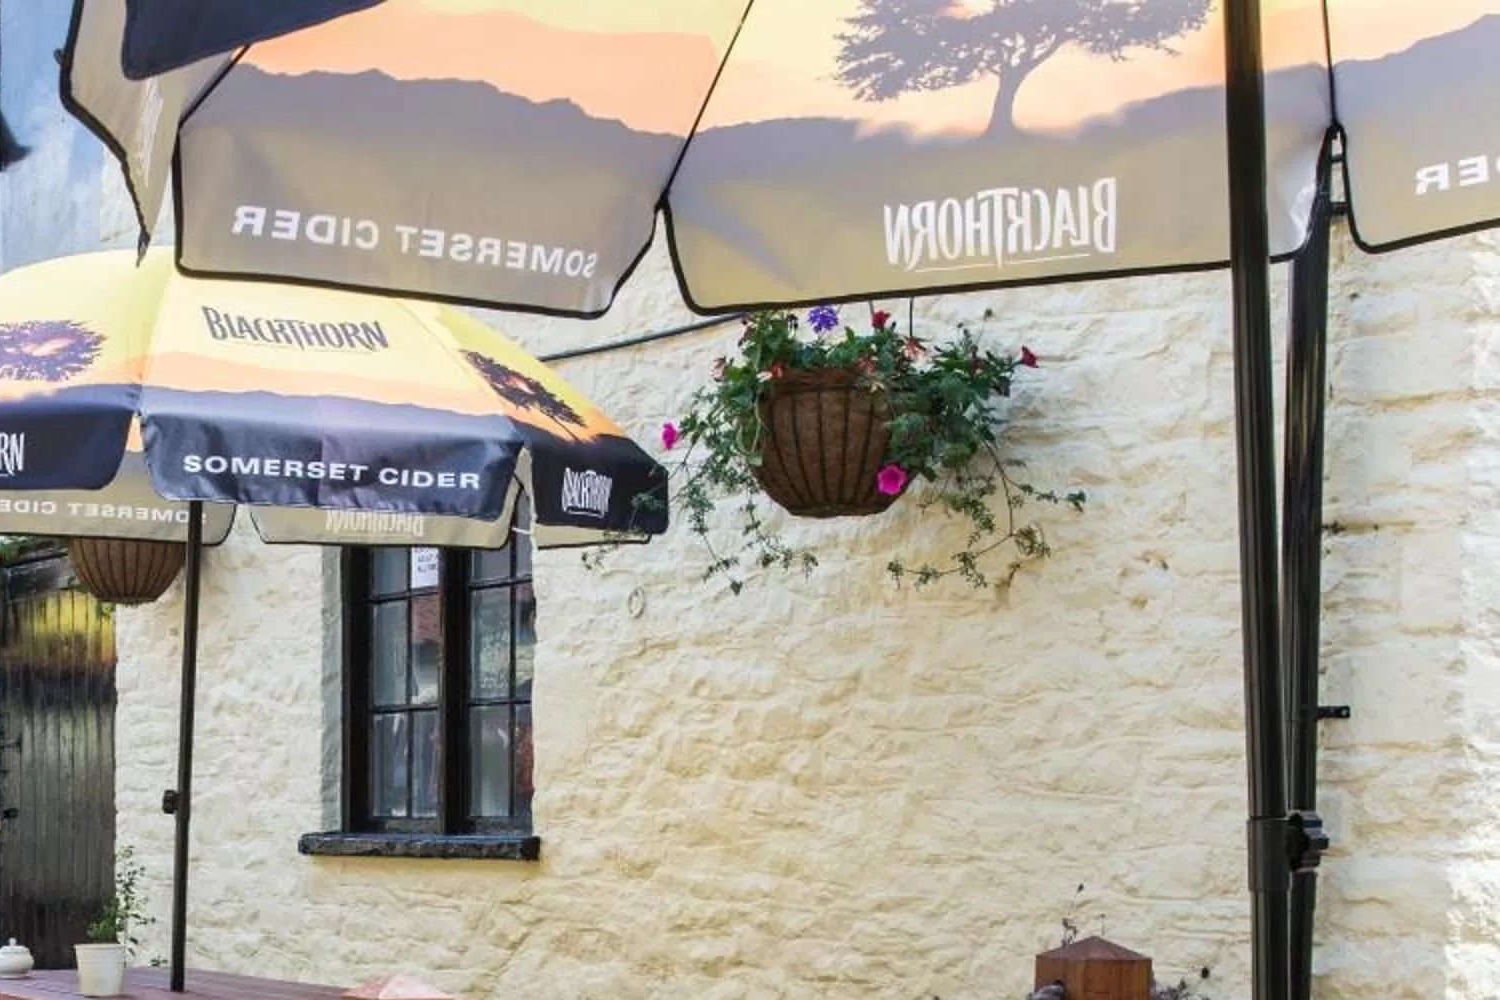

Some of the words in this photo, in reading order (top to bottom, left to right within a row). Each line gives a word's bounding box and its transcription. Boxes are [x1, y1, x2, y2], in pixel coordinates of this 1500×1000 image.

[201, 305, 389, 350] BLACKTHORN
[183, 455, 369, 481] SOMERSET
[379, 467, 481, 489] CIDER
